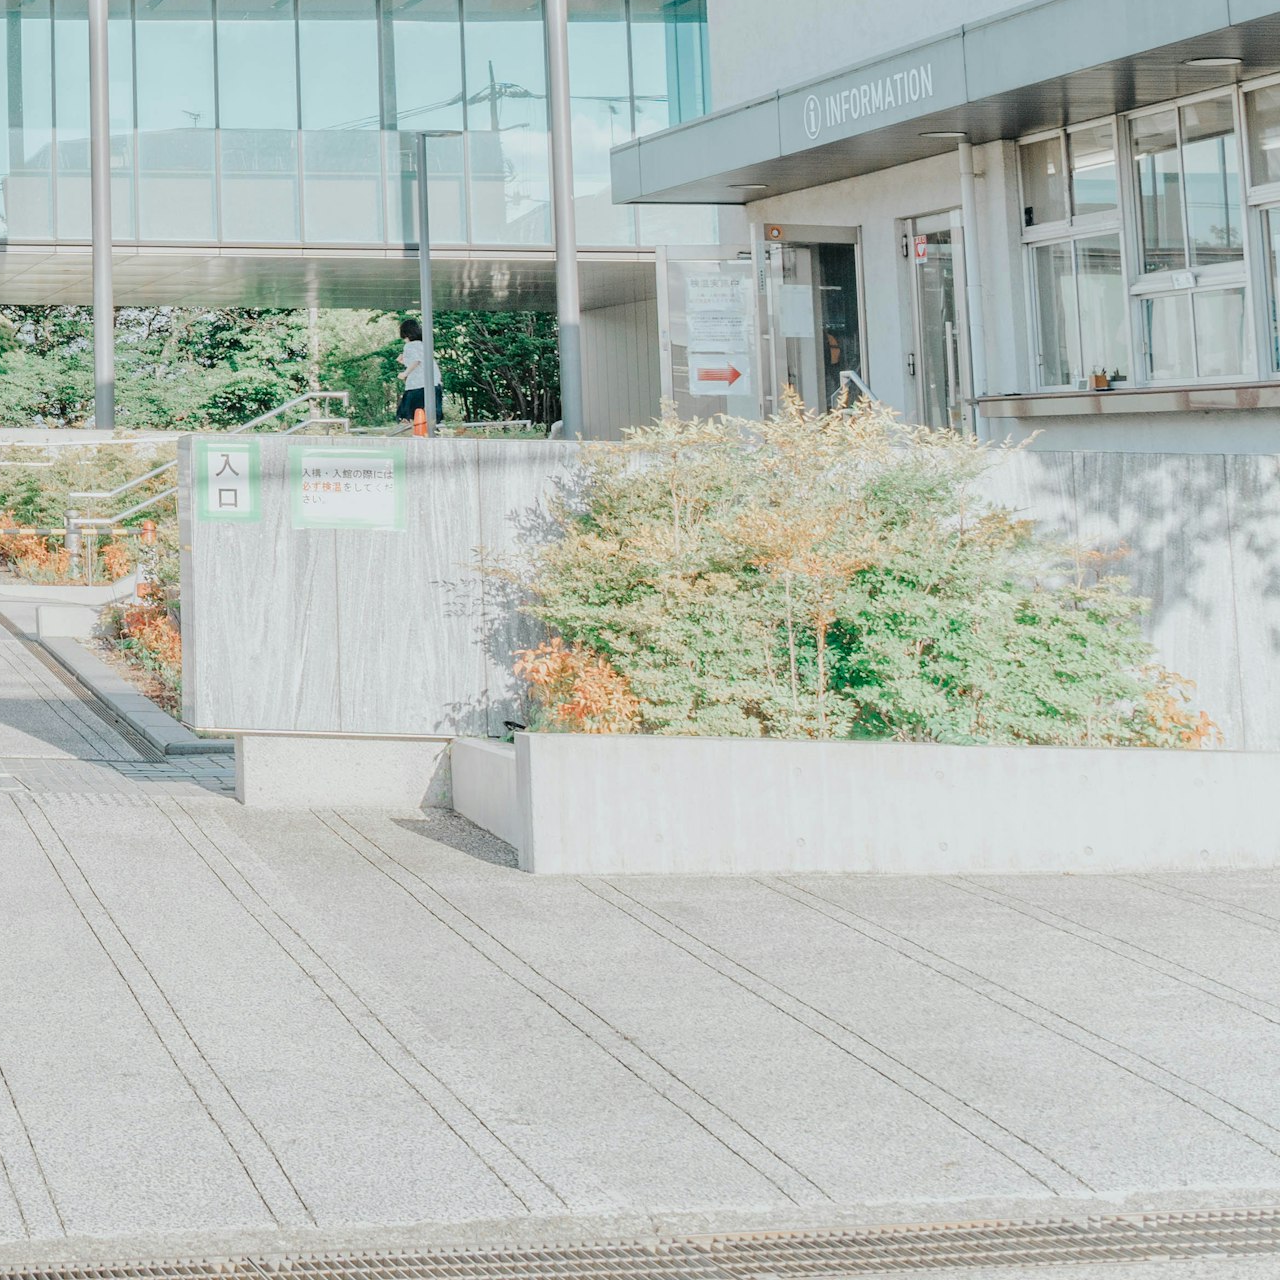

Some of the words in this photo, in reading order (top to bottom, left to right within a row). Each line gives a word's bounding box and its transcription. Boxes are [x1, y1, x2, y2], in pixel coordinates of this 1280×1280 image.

[825, 63, 933, 127] INFORMATION
[215, 454, 240, 508] 入口
[302, 467, 393, 480] 入構・入館の際には
